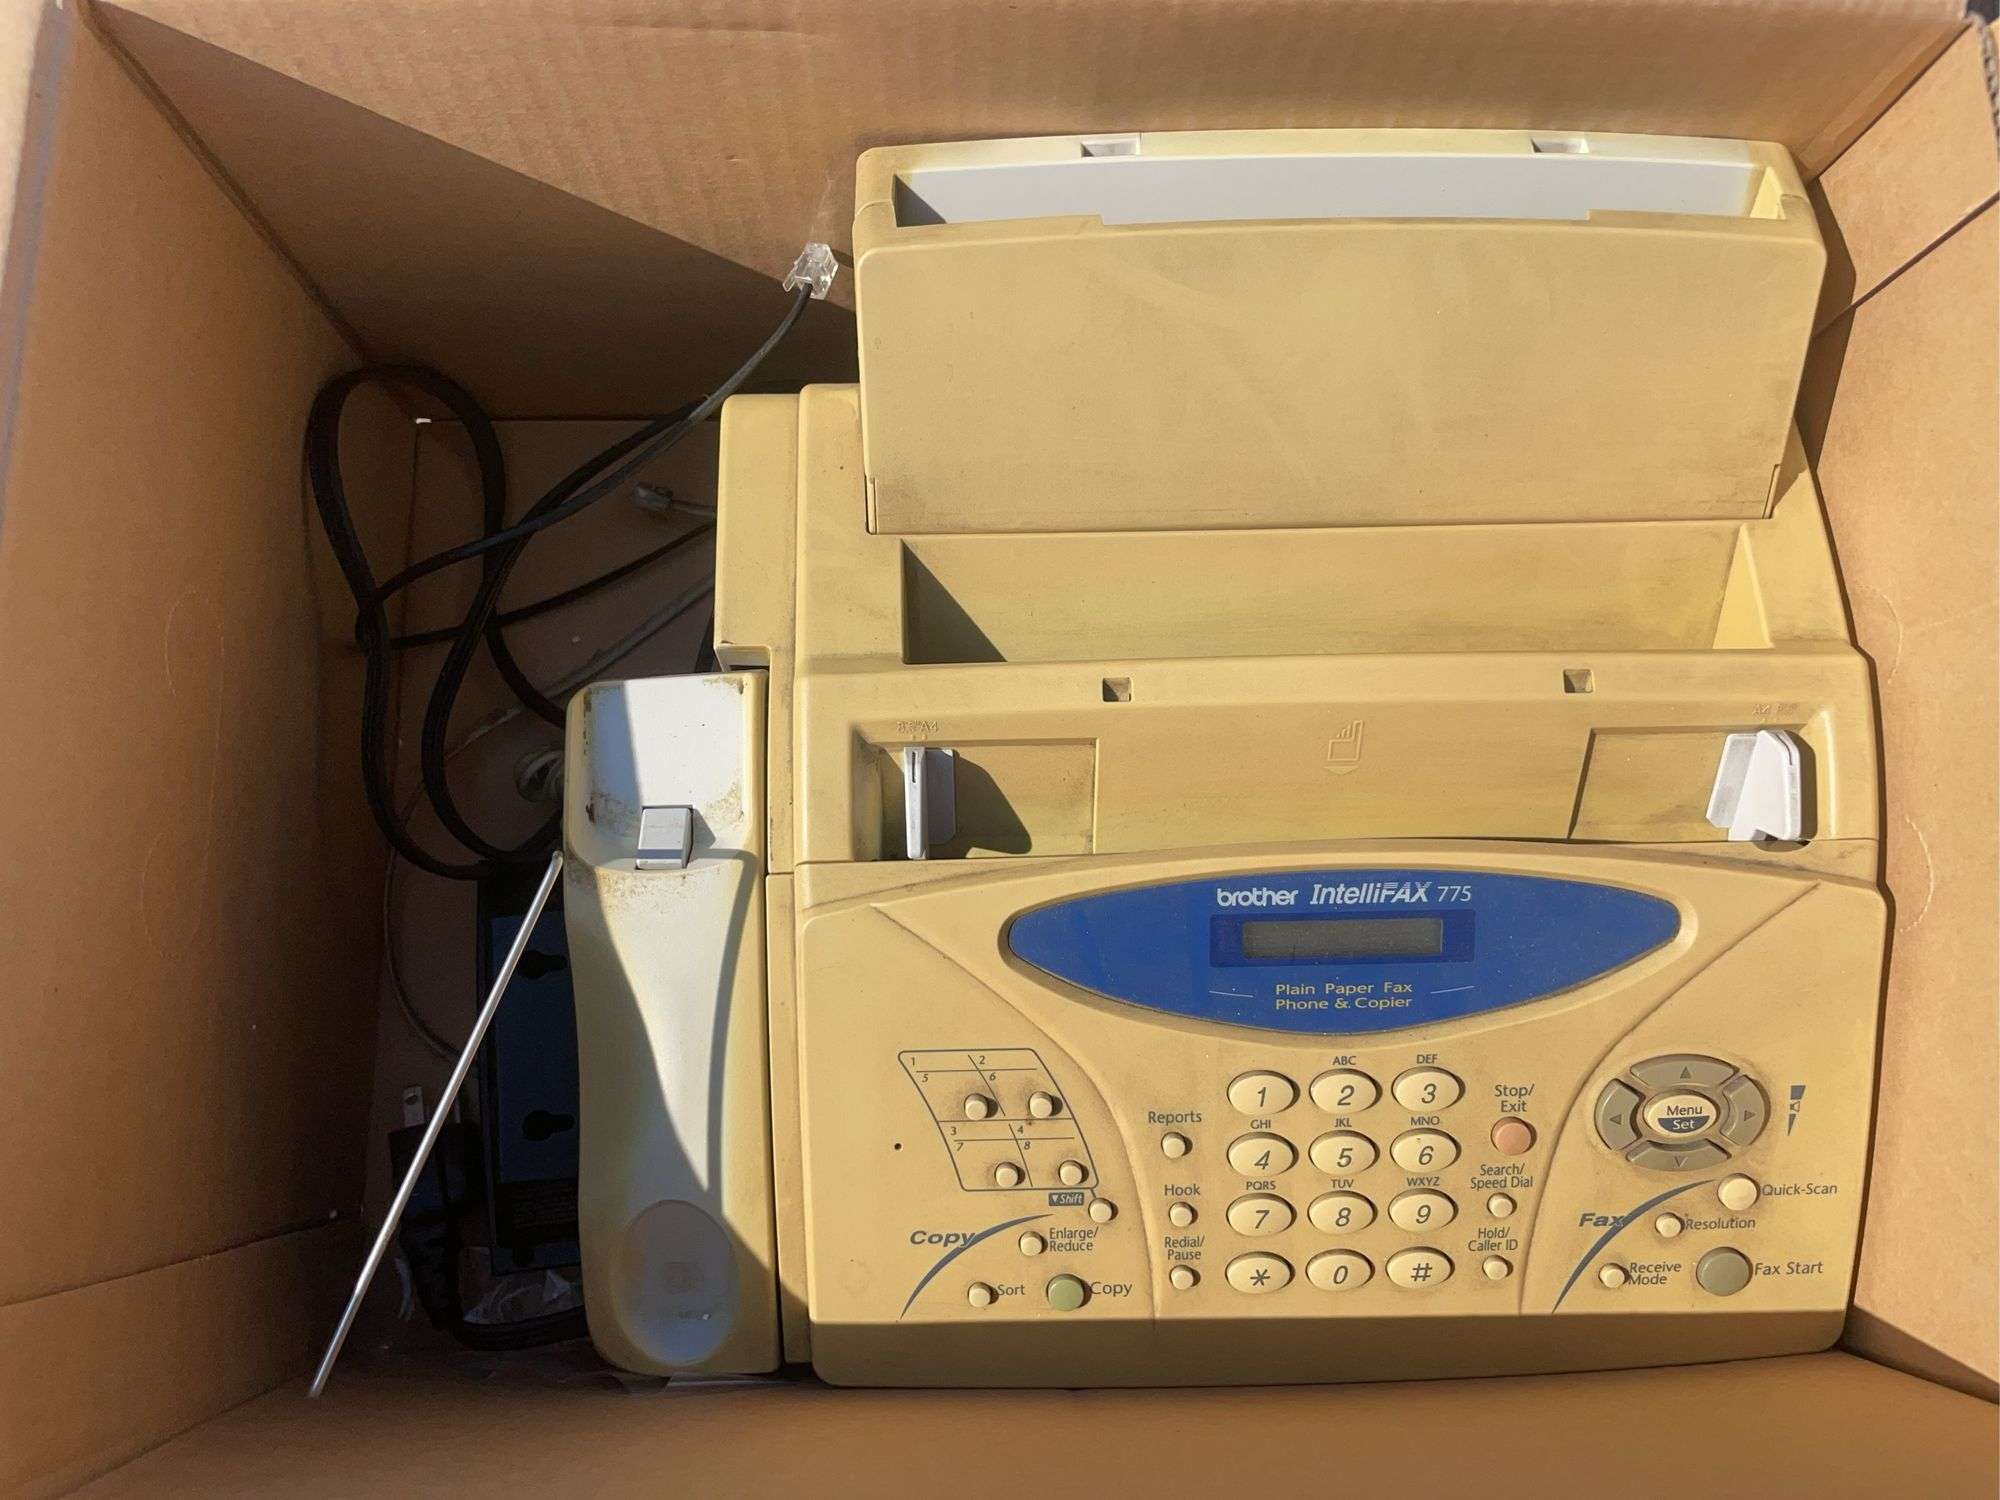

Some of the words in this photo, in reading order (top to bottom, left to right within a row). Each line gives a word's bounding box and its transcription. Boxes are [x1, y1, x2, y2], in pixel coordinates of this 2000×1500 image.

[1217, 887, 1298, 907] brother
[1309, 882, 1432, 905] IntelliFAX
[1437, 885, 1472, 902] 775
[1276, 983, 1316, 995] Plain
[1325, 983, 1374, 997] Paper
[1384, 982, 1413, 993] Fax
[1276, 998, 1328, 1010] Phone
[1334, 997, 1349, 1009] &
[1355, 997, 1413, 1010] Copier
[910, 1056, 916, 1066] 1
[979, 1055, 986, 1065] 2
[1332, 1055, 1356, 1066] ABC
[1416, 1054, 1438, 1064] DEF
[921, 1072, 929, 1083] 5
[989, 1071, 996, 1081] 6
[1257, 1086, 1267, 1107] 1
[1337, 1085, 1355, 1106] 2
[1421, 1083, 1437, 1104] 3
[1494, 1083, 1535, 1099] Stop/
[1501, 1100, 1527, 1113] Exit
[1666, 1104, 1703, 1116] Menu
[1148, 1111, 1202, 1125] Reports
[1250, 1119, 1271, 1129] GHI
[1334, 1118, 1352, 1128] JKL
[1410, 1116, 1440, 1126] MNO
[1017, 1125, 1024, 1135] 4
[1672, 1119, 1696, 1130] Set
[950, 1126, 957, 1136] 3
[956, 1142, 964, 1151] 7
[1024, 1141, 1031, 1151] 8
[1254, 1150, 1271, 1170] 4
[1337, 1148, 1353, 1168] 5
[1418, 1145, 1434, 1165] 6
[1480, 1163, 1525, 1176] Search/
[1246, 1181, 1276, 1191] PQRS
[1331, 1179, 1354, 1189] TUV
[1407, 1177, 1440, 1187] WXYZ
[1470, 1177, 1507, 1190] Speed
[1511, 1176, 1533, 1188] Dial
[1164, 1184, 1200, 1196] Hook
[1761, 1183, 1837, 1198] Quick-Scan
[1060, 1194, 1082, 1204] Shift
[1255, 1210, 1269, 1229] 7
[1335, 1207, 1351, 1227] 8
[1416, 1204, 1431, 1224] 9
[1578, 1213, 1625, 1227] Fax
[1685, 1217, 1756, 1230] Resolution
[909, 1230, 977, 1248] Copy
[1049, 1226, 1099, 1241] Enlarge/
[1477, 1227, 1510, 1239] Hold/
[1049, 1240, 1093, 1252] Reduce
[1164, 1235, 1205, 1248] Redial/
[1468, 1240, 1502, 1251] Caller
[1505, 1239, 1518, 1250] ID
[1167, 1249, 1201, 1261] Pause
[1411, 1263, 1432, 1281] #
[1629, 1262, 1681, 1274] Receive
[1754, 1263, 1780, 1276] Fax
[1786, 1261, 1823, 1275] Start
[1333, 1265, 1348, 1284] 0
[1628, 1274, 1667, 1286] Mode
[997, 1284, 1025, 1296] Sort
[1091, 1281, 1133, 1297] Copy
